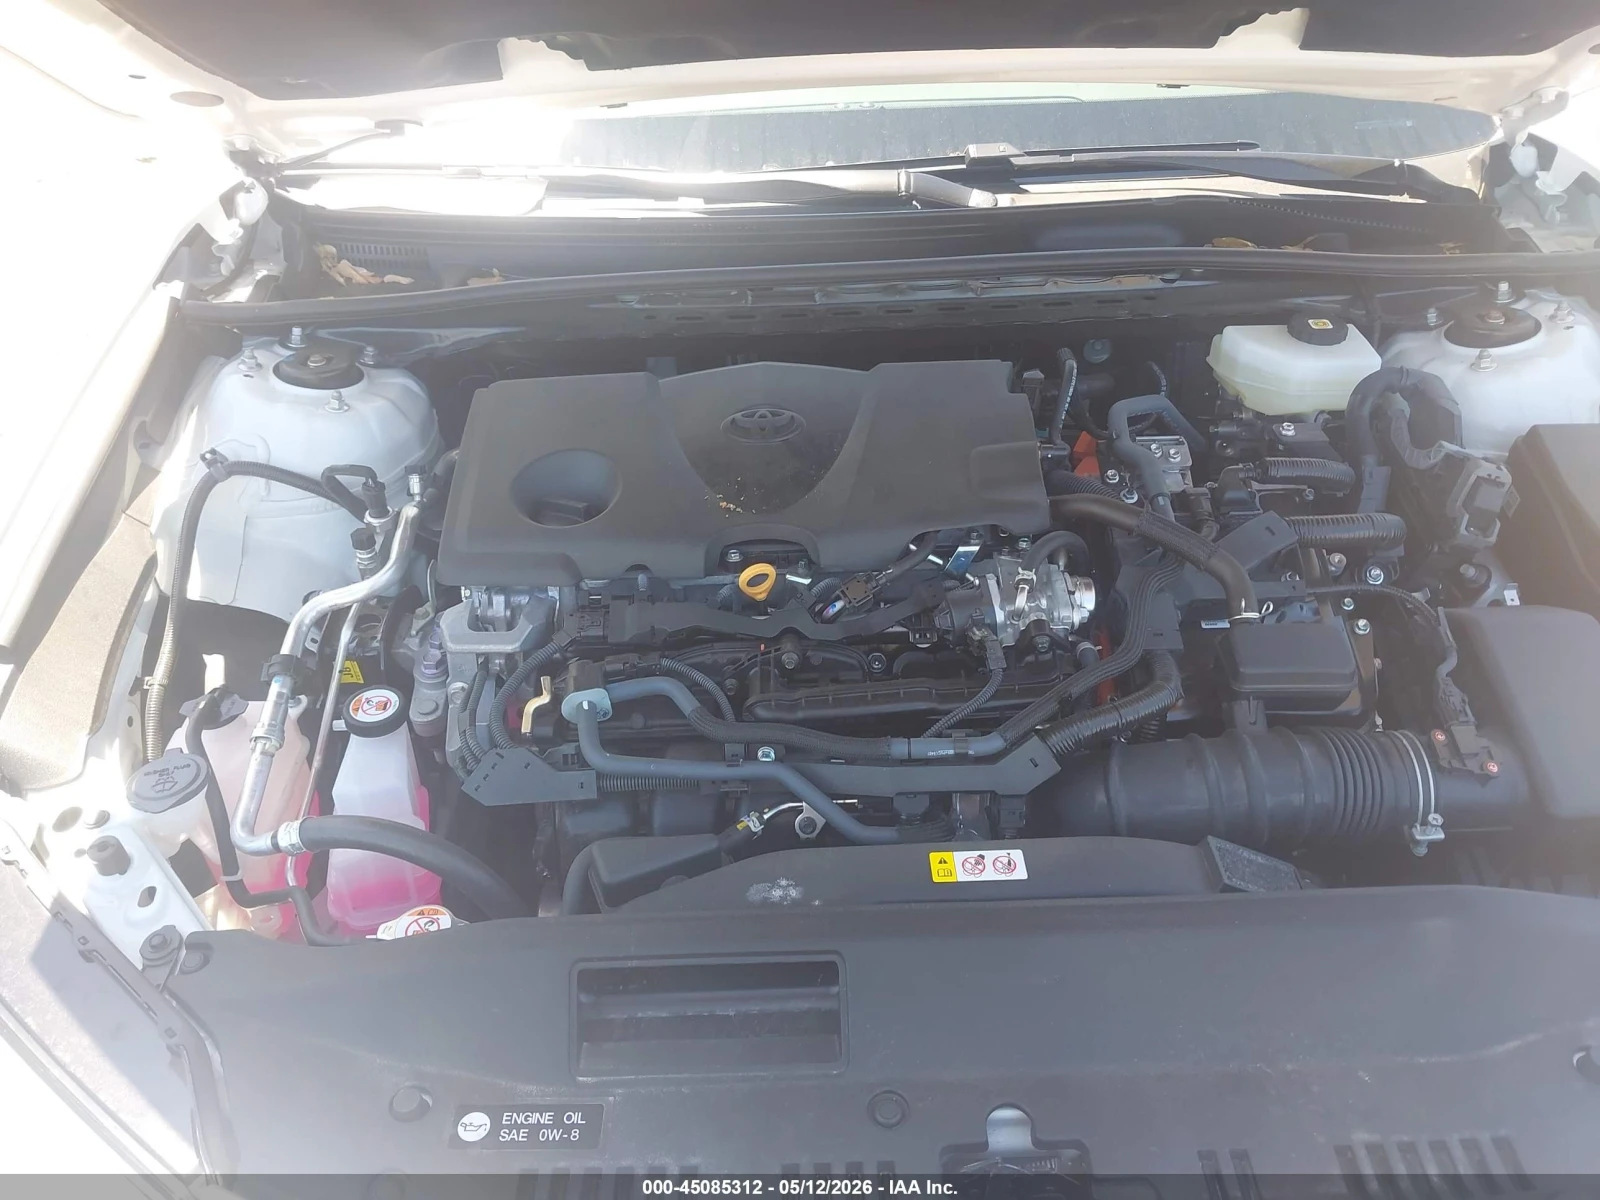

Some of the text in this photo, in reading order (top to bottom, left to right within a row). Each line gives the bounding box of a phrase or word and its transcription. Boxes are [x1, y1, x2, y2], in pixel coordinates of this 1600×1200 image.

[502, 1112, 586, 1124] ENGINE OIL
[499, 1129, 580, 1141] SAE 0W-8
